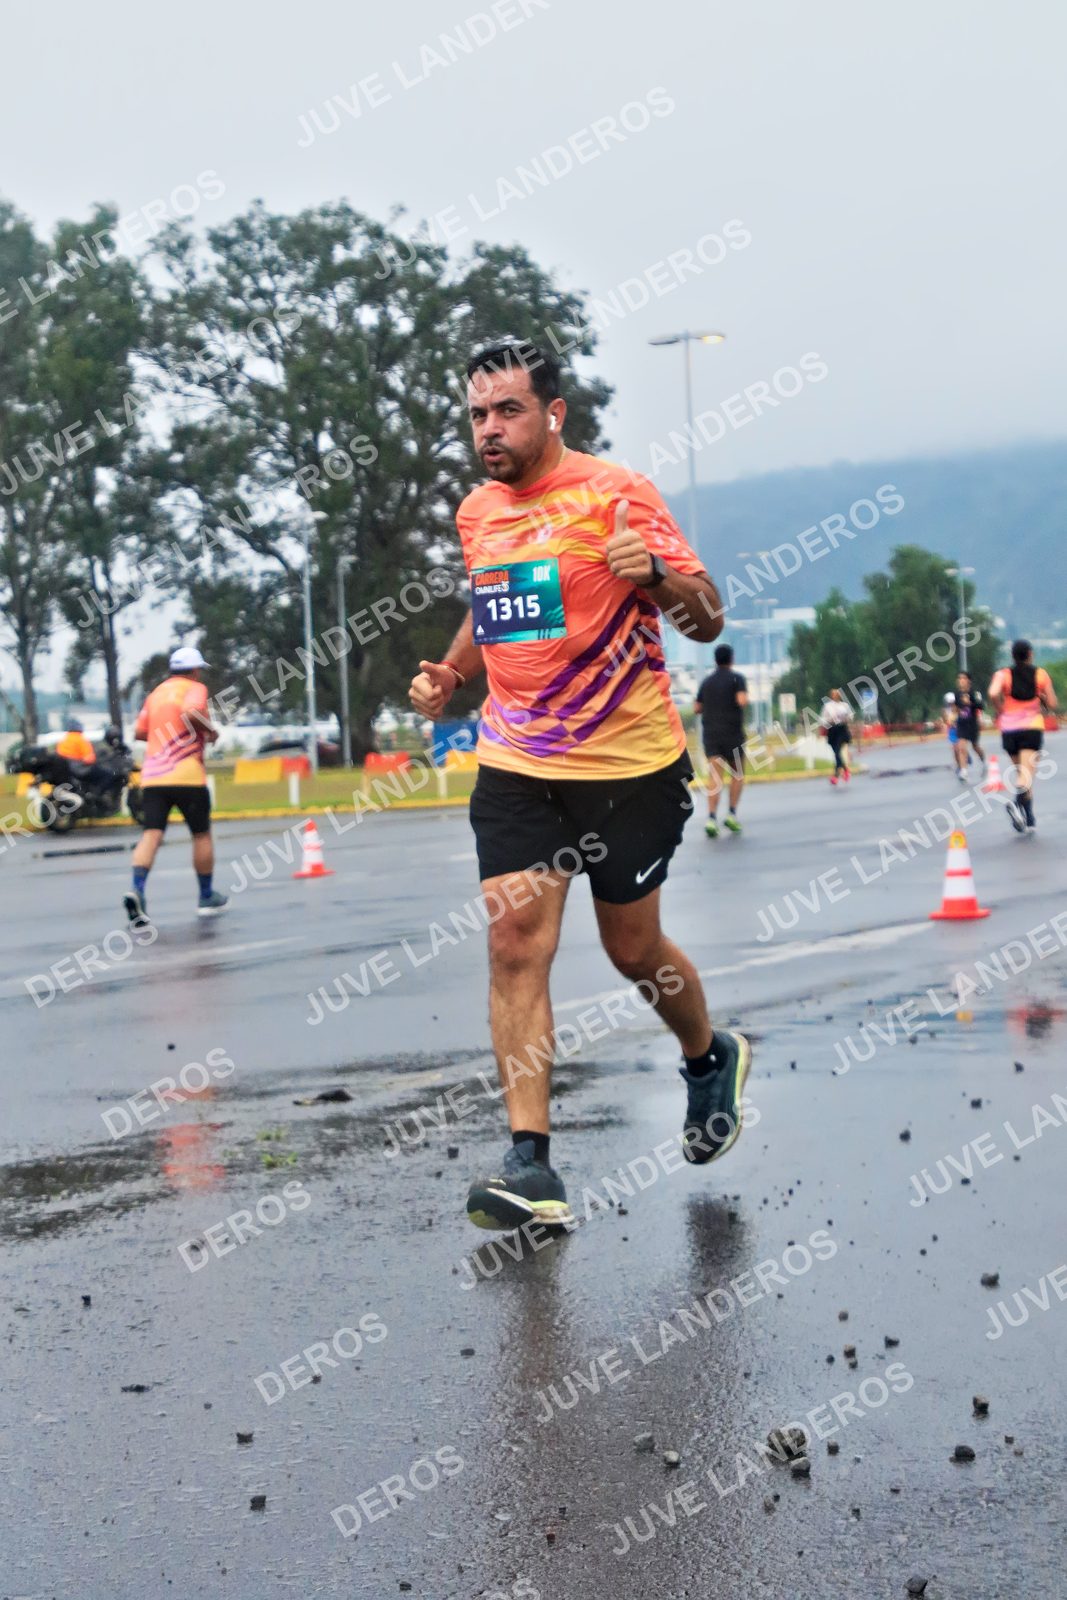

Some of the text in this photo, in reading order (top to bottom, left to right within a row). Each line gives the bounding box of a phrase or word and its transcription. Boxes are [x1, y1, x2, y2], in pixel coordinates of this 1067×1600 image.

[475, 570, 509, 587] CARRERA
[532, 565, 551, 582] 10K
[486, 594, 541, 621] 1315
